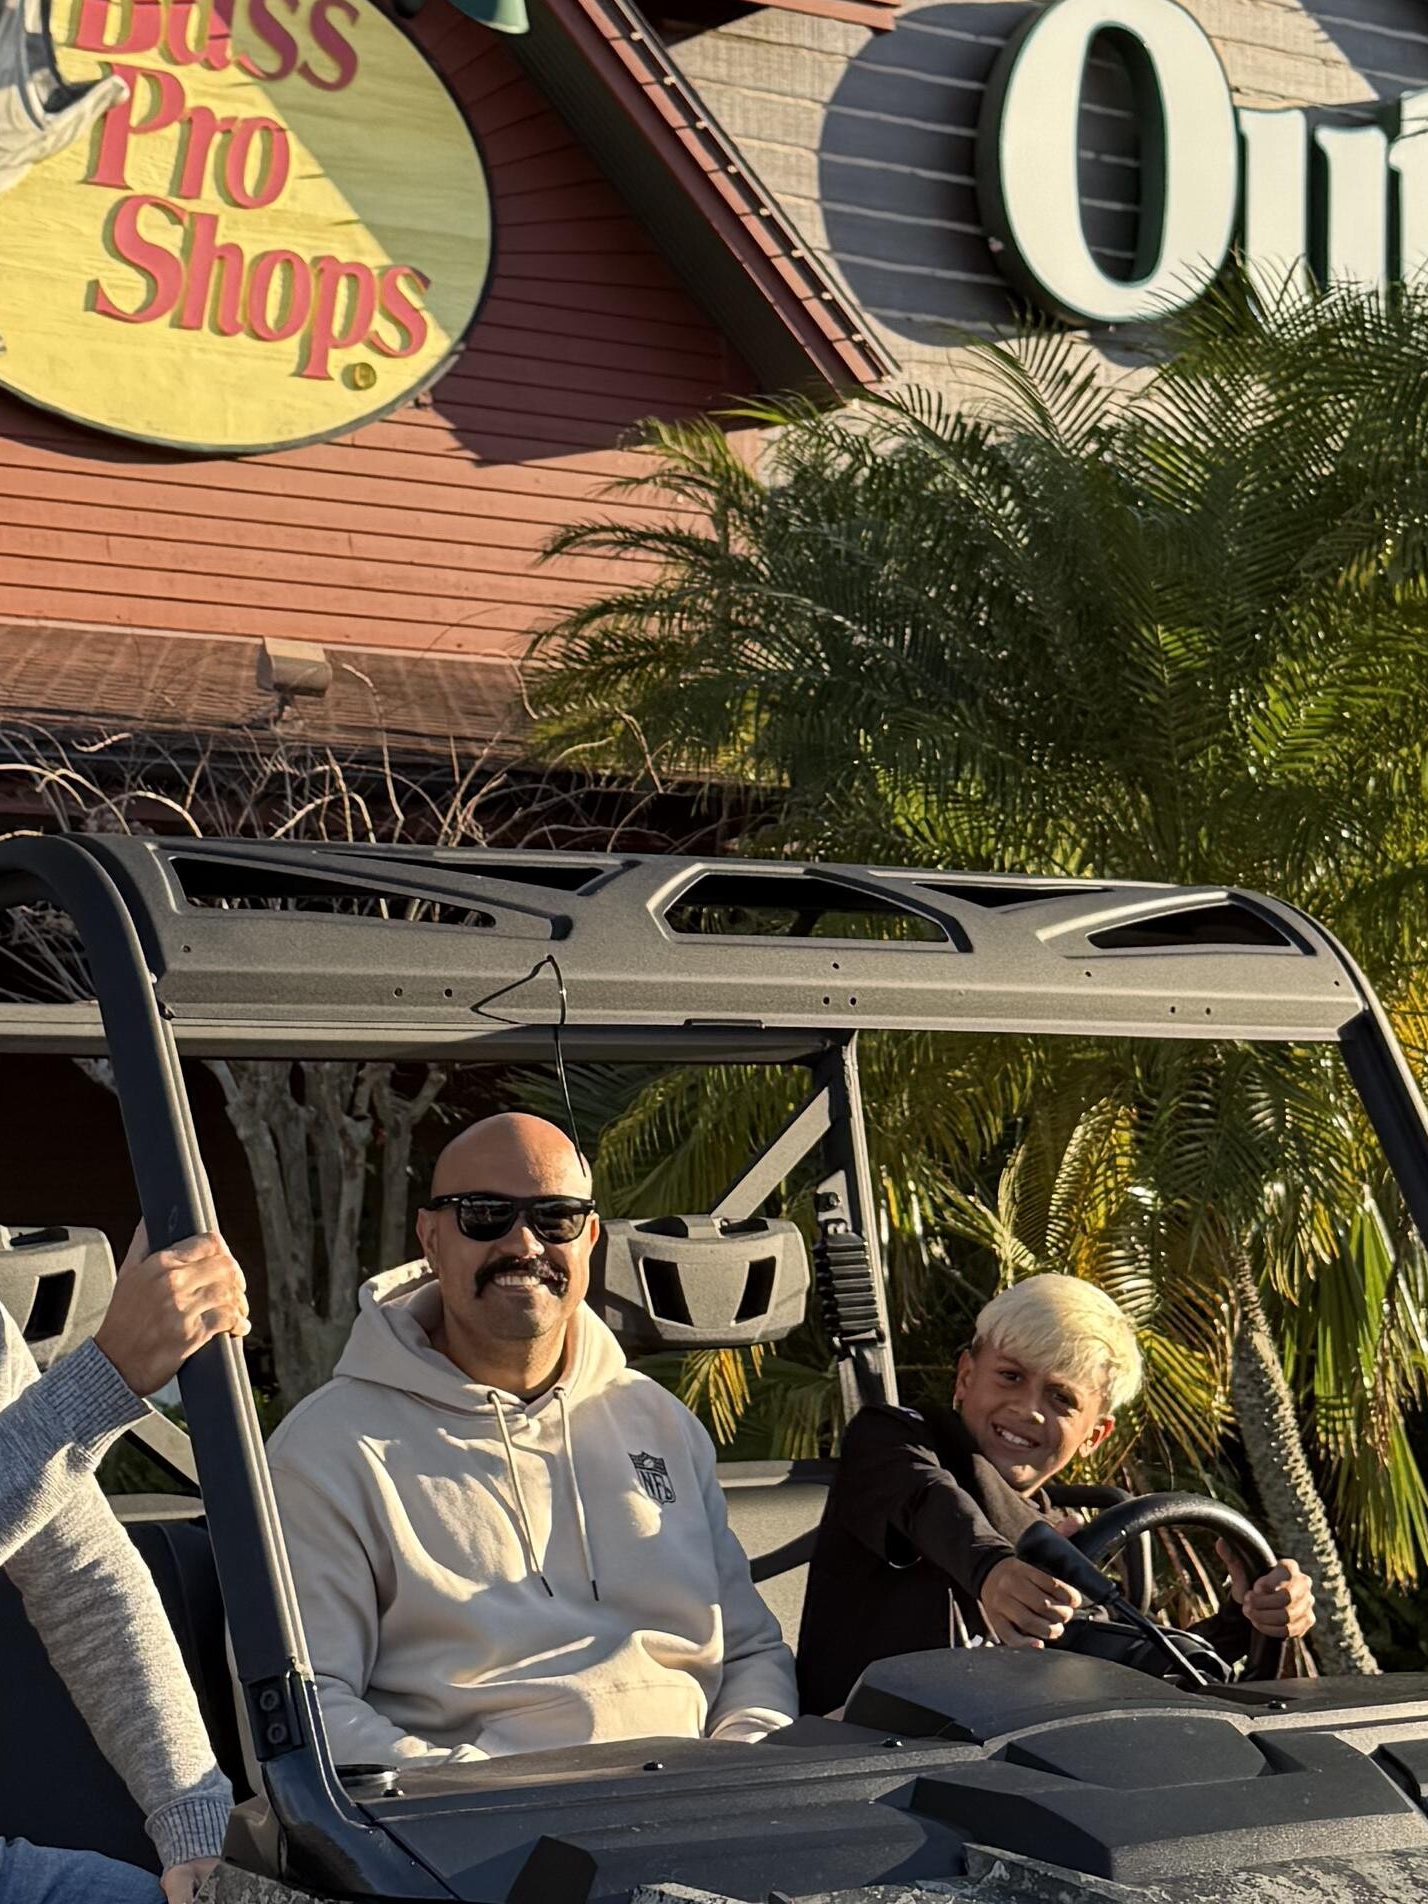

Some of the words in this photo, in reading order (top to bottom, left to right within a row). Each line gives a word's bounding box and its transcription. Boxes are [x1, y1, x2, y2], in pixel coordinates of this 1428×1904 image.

[82, 61, 291, 210] Pro
[87, 194, 431, 381] Shops
[639, 1470, 673, 1501] NFL
